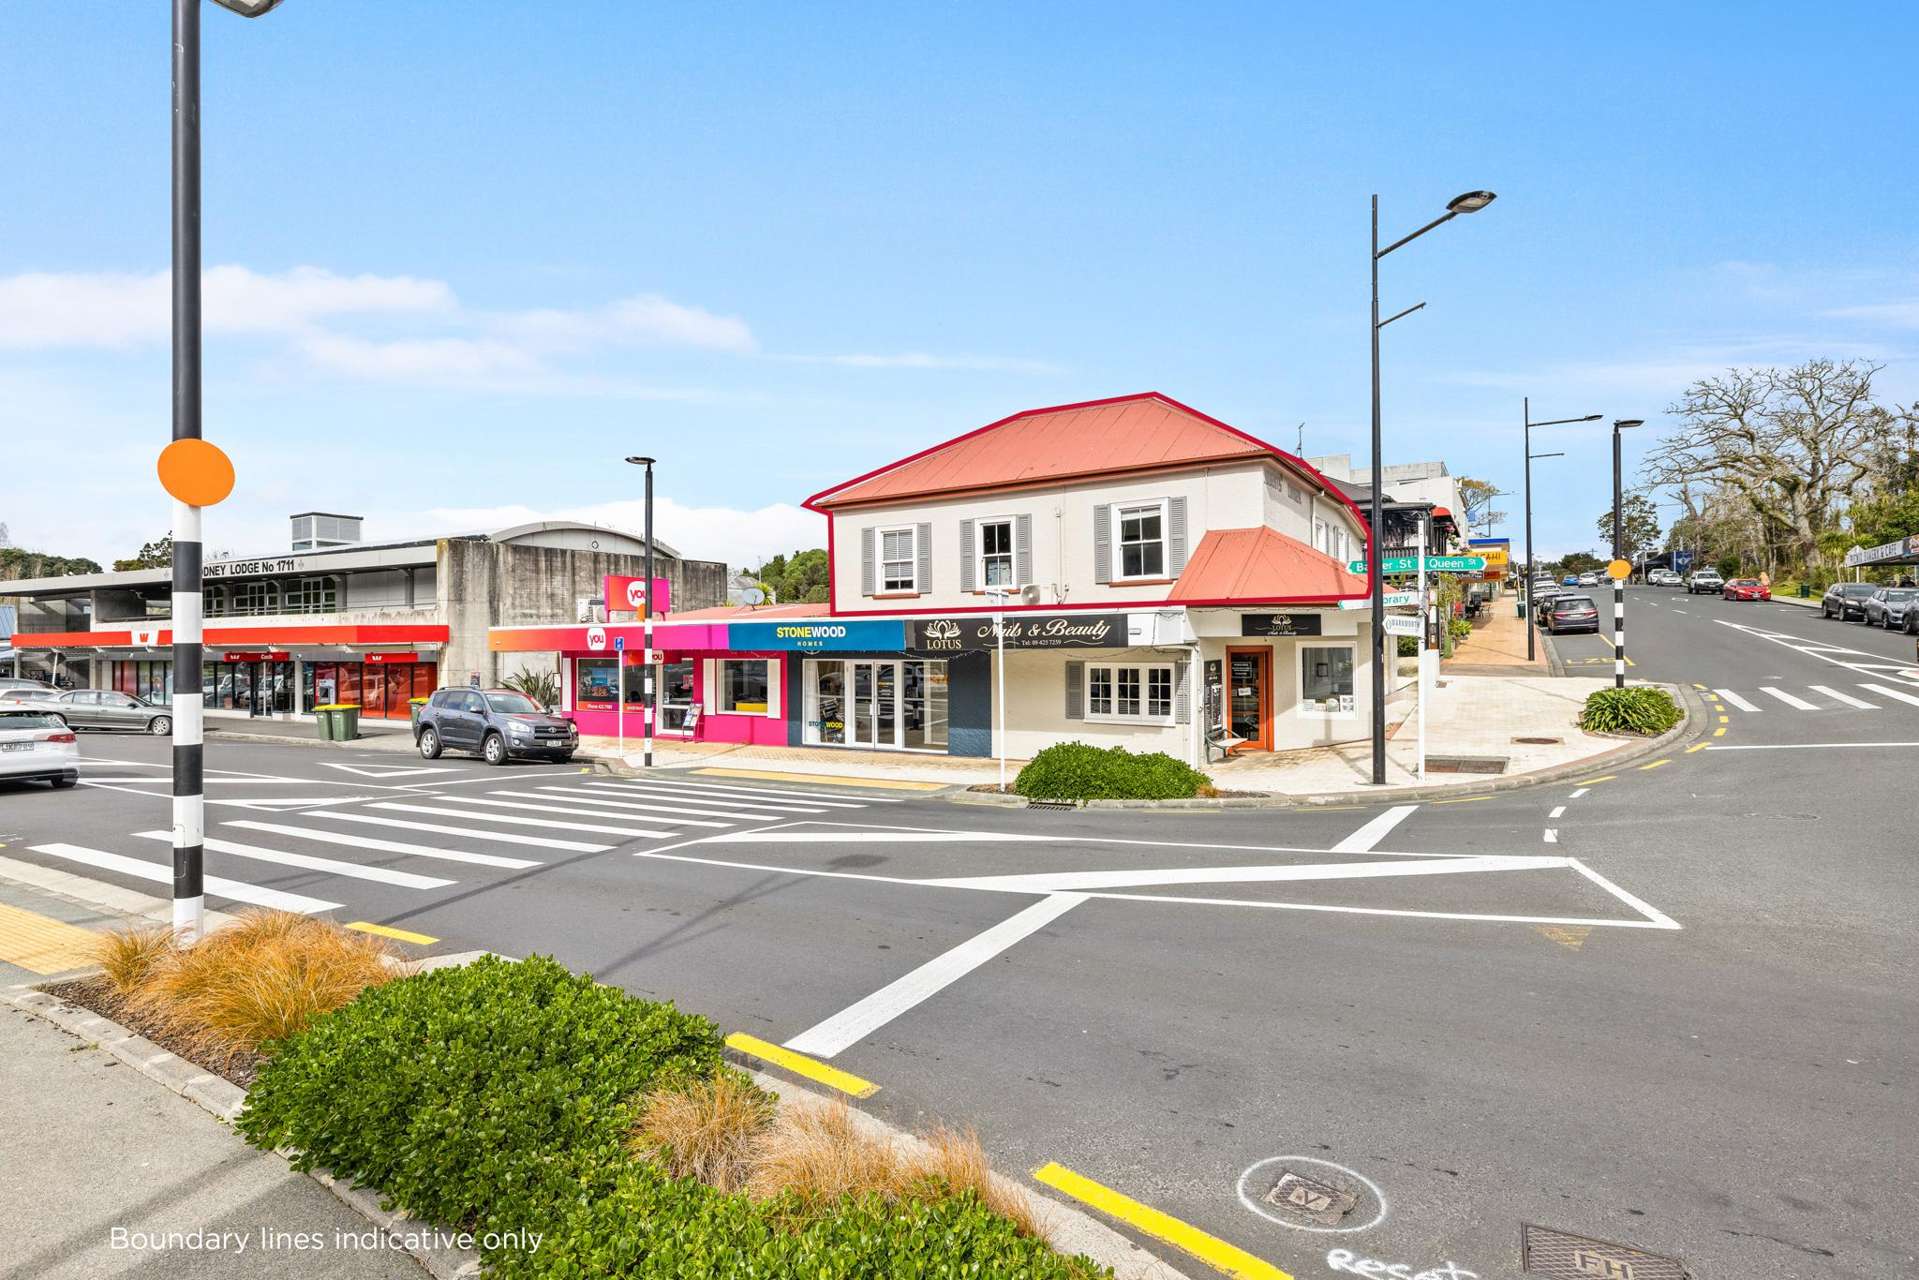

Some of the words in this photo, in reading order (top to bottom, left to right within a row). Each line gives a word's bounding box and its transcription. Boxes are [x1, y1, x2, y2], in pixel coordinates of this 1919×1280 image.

[230, 562, 259, 574] LODGE
[262, 562, 274, 572] No
[277, 560, 294, 571] 1711
[1400, 558, 1413, 569] St
[1429, 558, 1464, 569] Queen
[776, 626, 846, 638] STONEWOOD
[1028, 623, 1041, 637] &
[1042, 618, 1111, 640] Beauty
[590, 635, 604, 646] you
[927, 639, 962, 649] LOTUS
